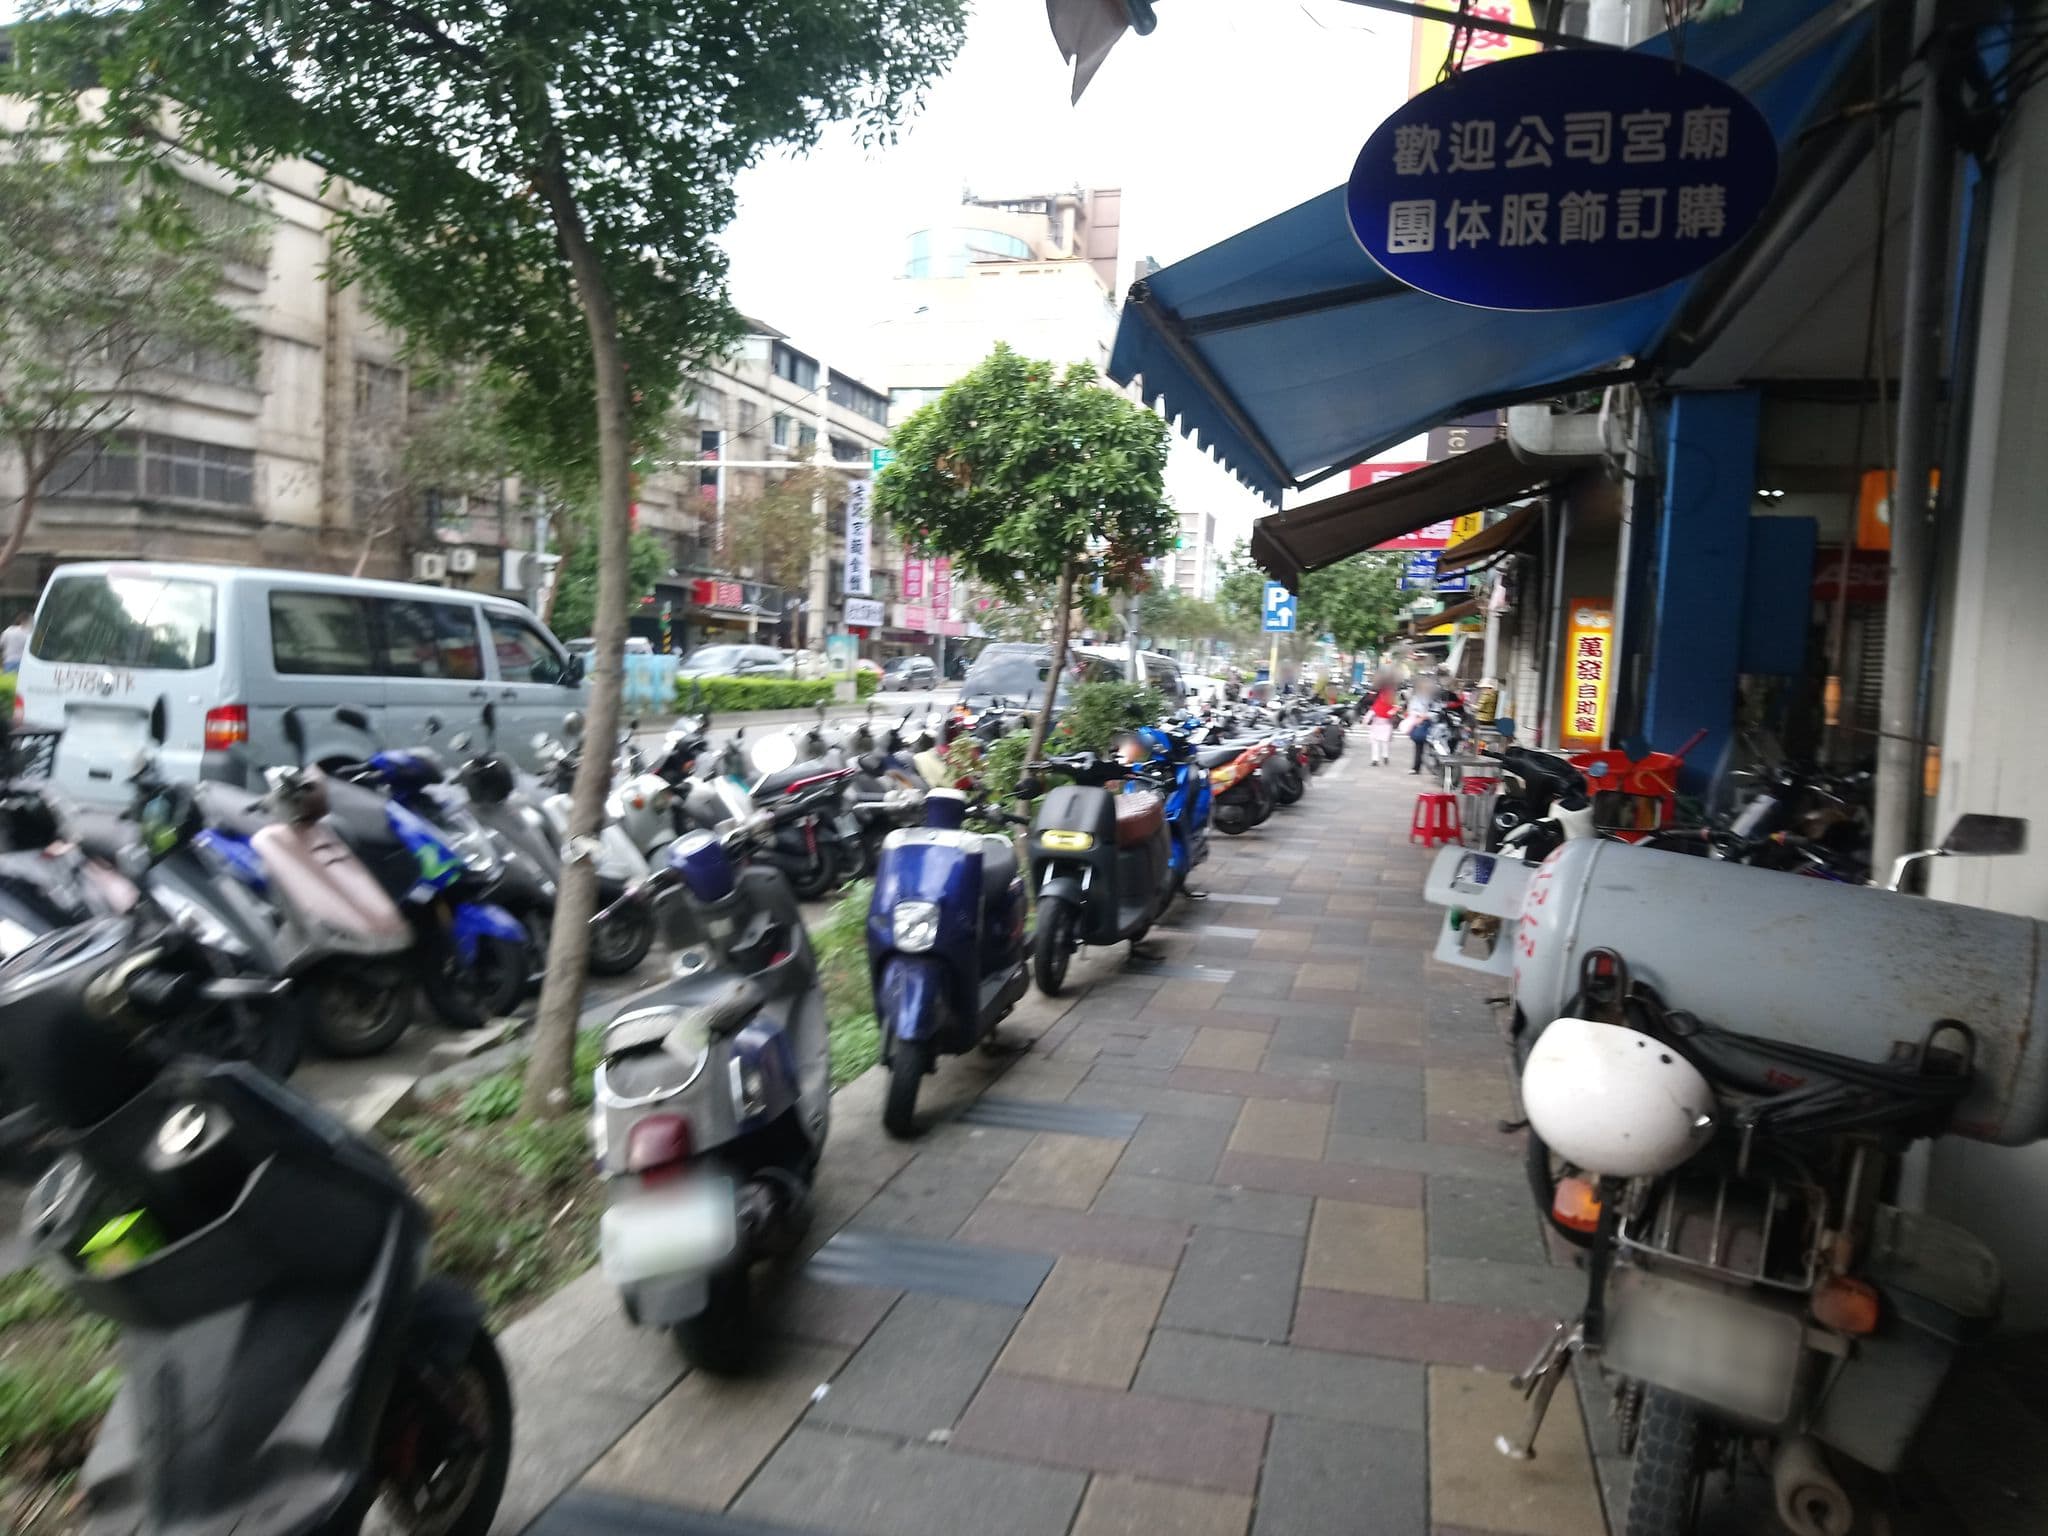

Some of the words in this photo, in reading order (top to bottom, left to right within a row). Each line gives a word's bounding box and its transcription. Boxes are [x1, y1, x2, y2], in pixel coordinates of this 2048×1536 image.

[1392, 104, 1732, 177] 歡迎公司宮廟
[1386, 184, 1728, 255] 團体服飾訂購
[1267, 587, 1290, 611] P
